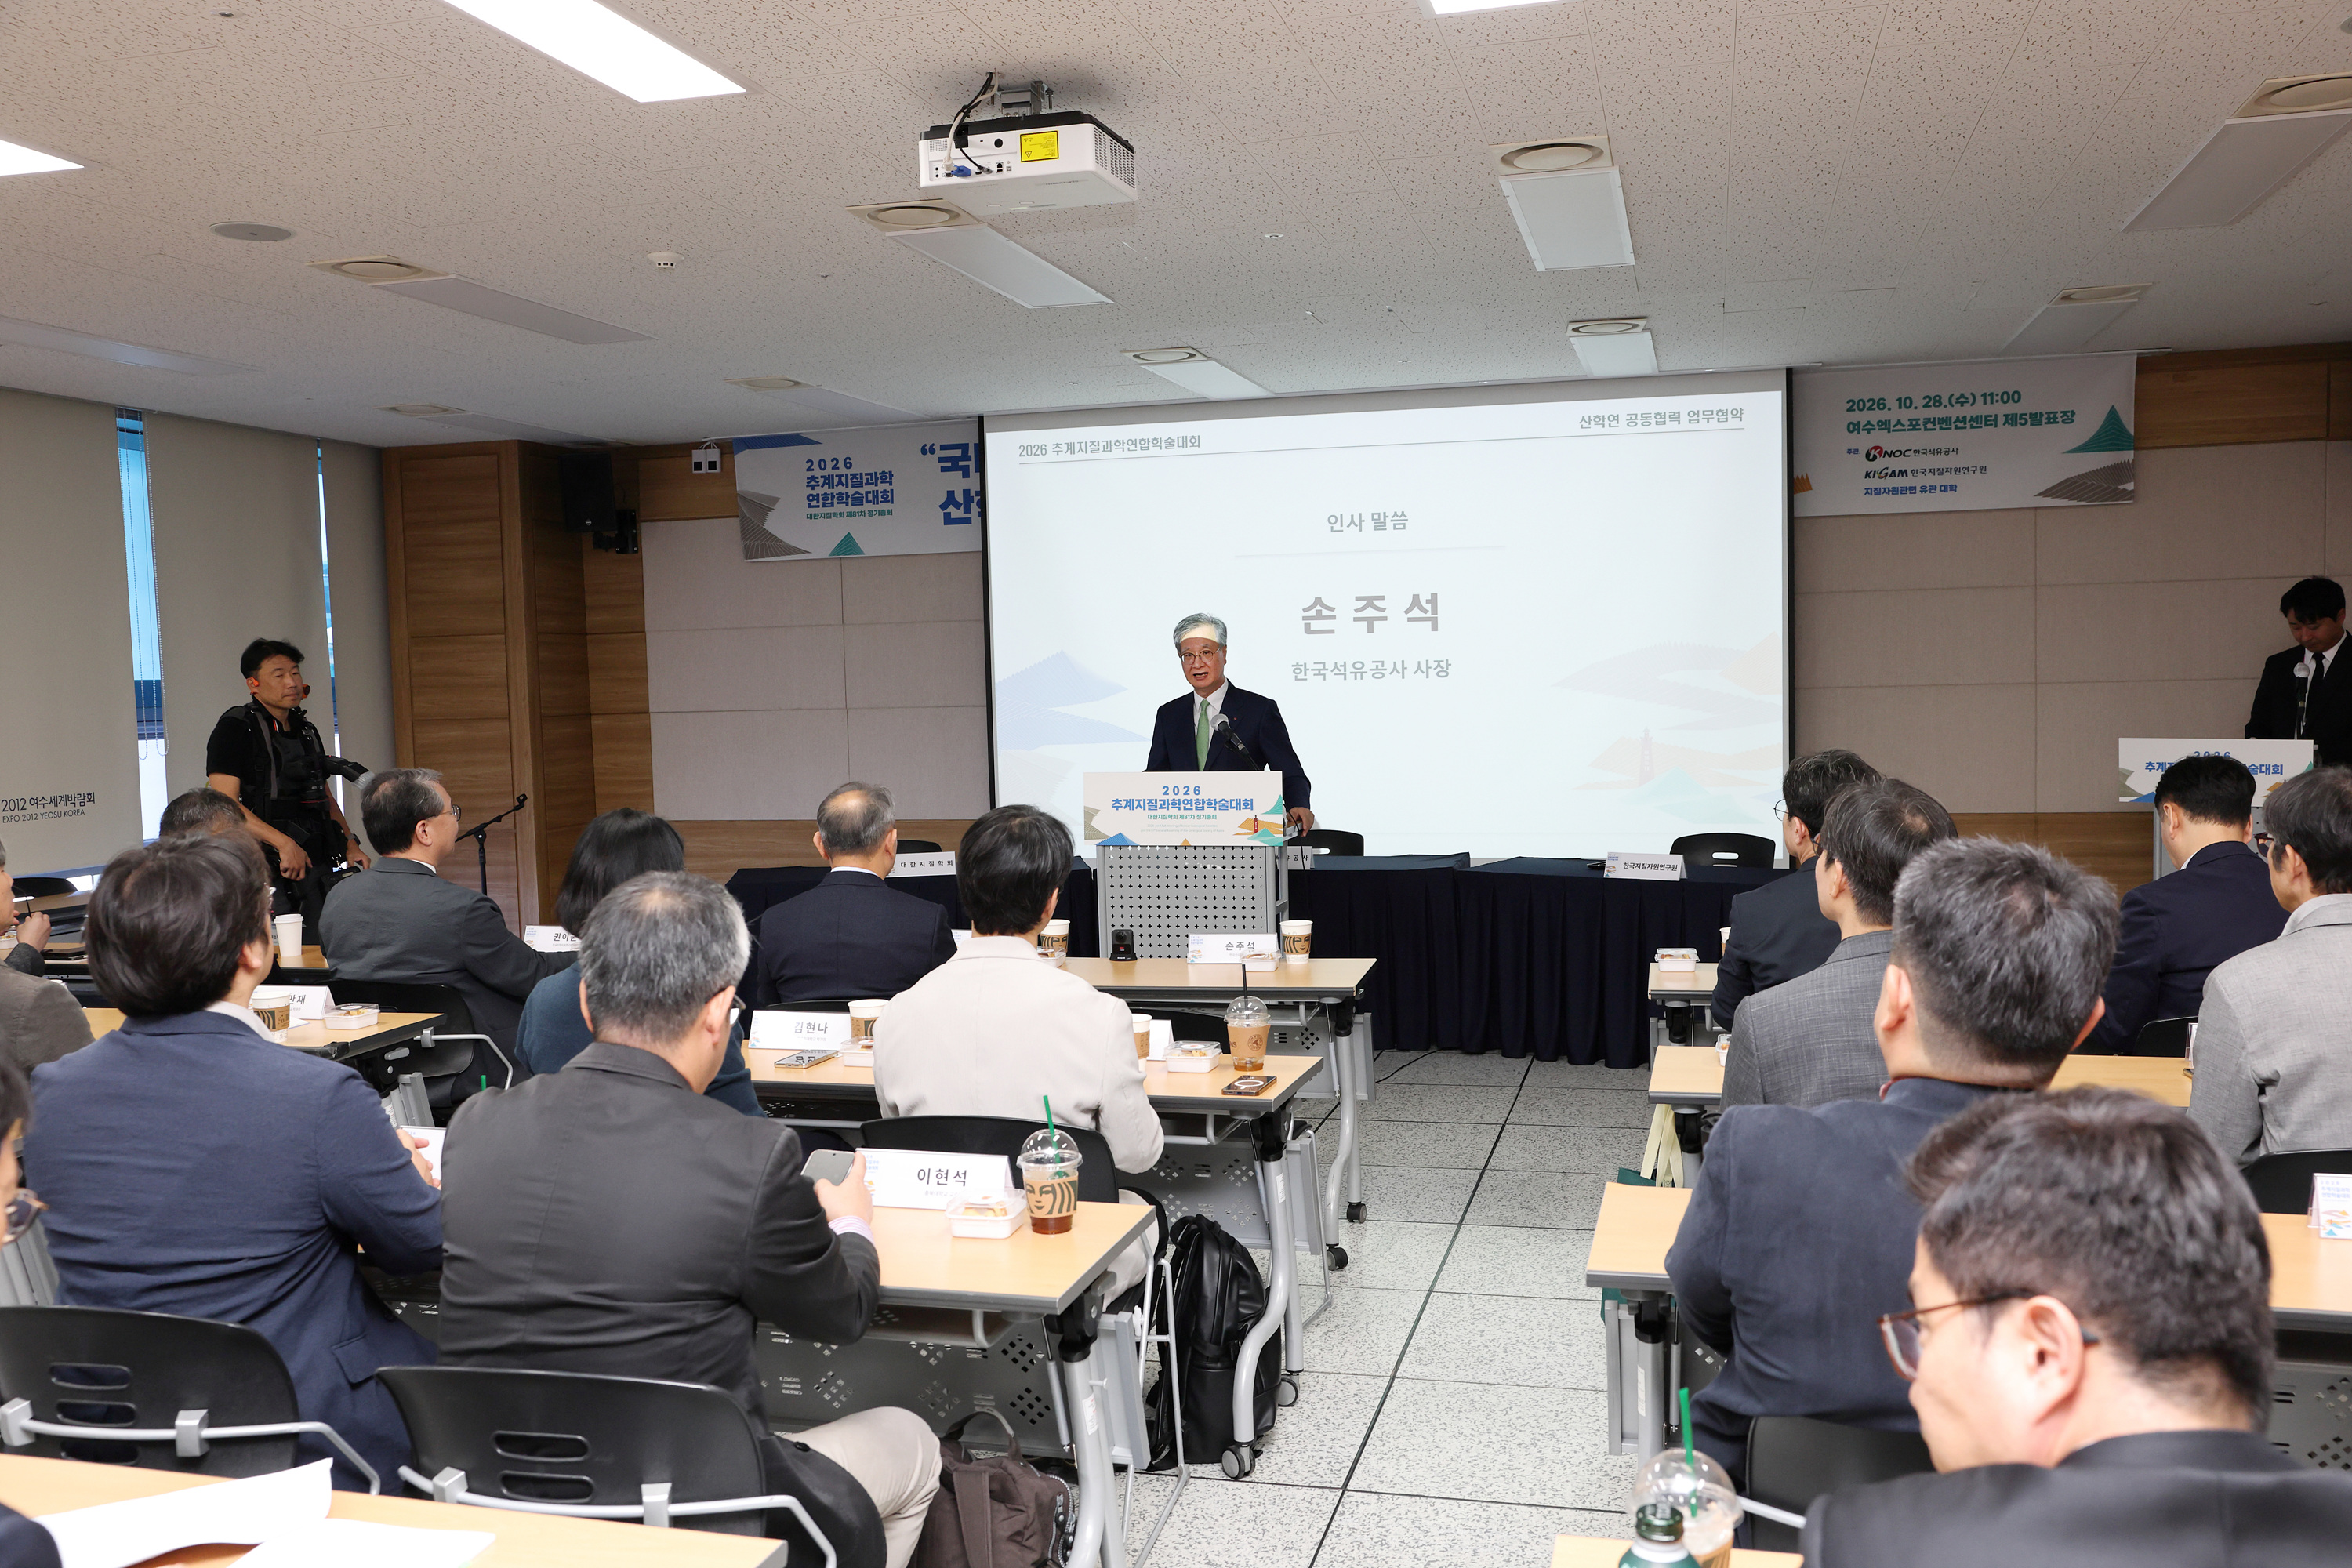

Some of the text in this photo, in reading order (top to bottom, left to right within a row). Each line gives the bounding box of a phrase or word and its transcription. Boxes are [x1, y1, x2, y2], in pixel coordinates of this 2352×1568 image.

[1846, 397, 1892, 412] 2026.
[1896, 396, 1918, 410] 10.
[1980, 390, 2022, 405] 11:00
[1579, 408, 1744, 430] 산학연 공동협력 업무협약
[1846, 409, 2076, 434] 여수엑스포컨벤션센터 제5발표장
[1018, 435, 1201, 457] 2026 추계지질과학연합학술대회
[1913, 448, 1959, 457] 한국석유공사
[805, 456, 853, 472] 2026
[806, 470, 895, 491] 추계지질과학
[1864, 466, 1987, 480] KIGAM 한국지질자원연구원
[1864, 484, 1958, 495] 지질자원관련 유관 대학
[806, 488, 895, 509] 연합학술대회
[806, 511, 845, 520] 대한지질학회
[867, 509, 893, 517] 정기총회
[1327, 510, 1409, 533] 인사 말씀
[1291, 659, 1452, 681] 한국석유공사 사장
[1162, 786, 1201, 796] 2026
[1, 792, 95, 812] 2012 여수세계박람회
[1111, 798, 1254, 811] 추계지질과학연합학술대회
[2, 815, 20, 823] EXPO
[22, 813, 38, 822] 2012
[40, 811, 62, 819] YEOSU
[1623, 862, 1678, 872] 한국지질자원연구원
[794, 1022, 828, 1034] 김현나
[917, 1168, 967, 1187] 이현석
